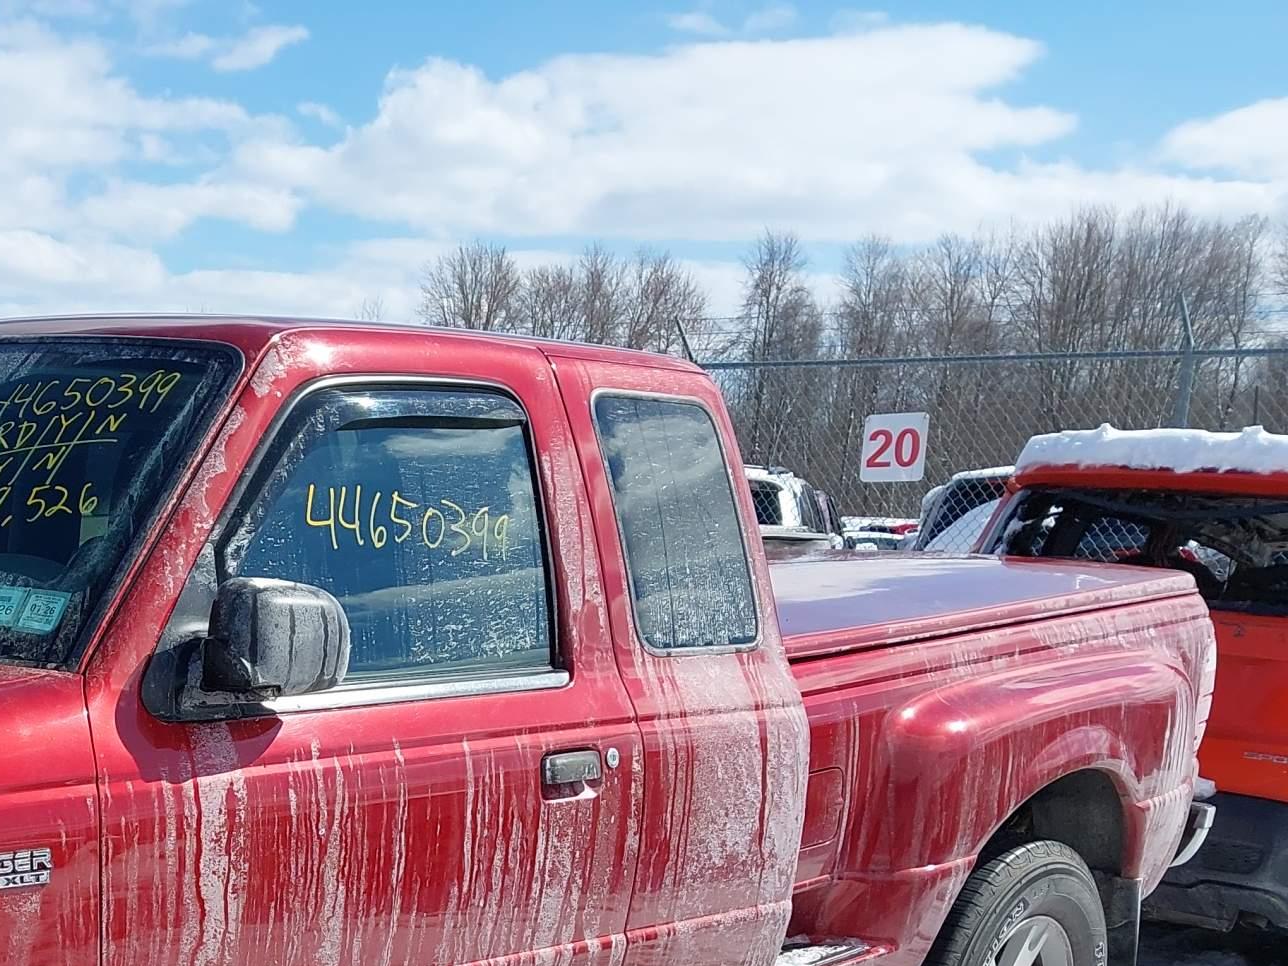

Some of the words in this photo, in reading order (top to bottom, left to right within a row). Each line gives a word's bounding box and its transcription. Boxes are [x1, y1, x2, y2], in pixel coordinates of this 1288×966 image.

[866, 427, 920, 468] 20
[306, 484, 508, 561] 44650399
[1, 873, 49, 888] XLT
